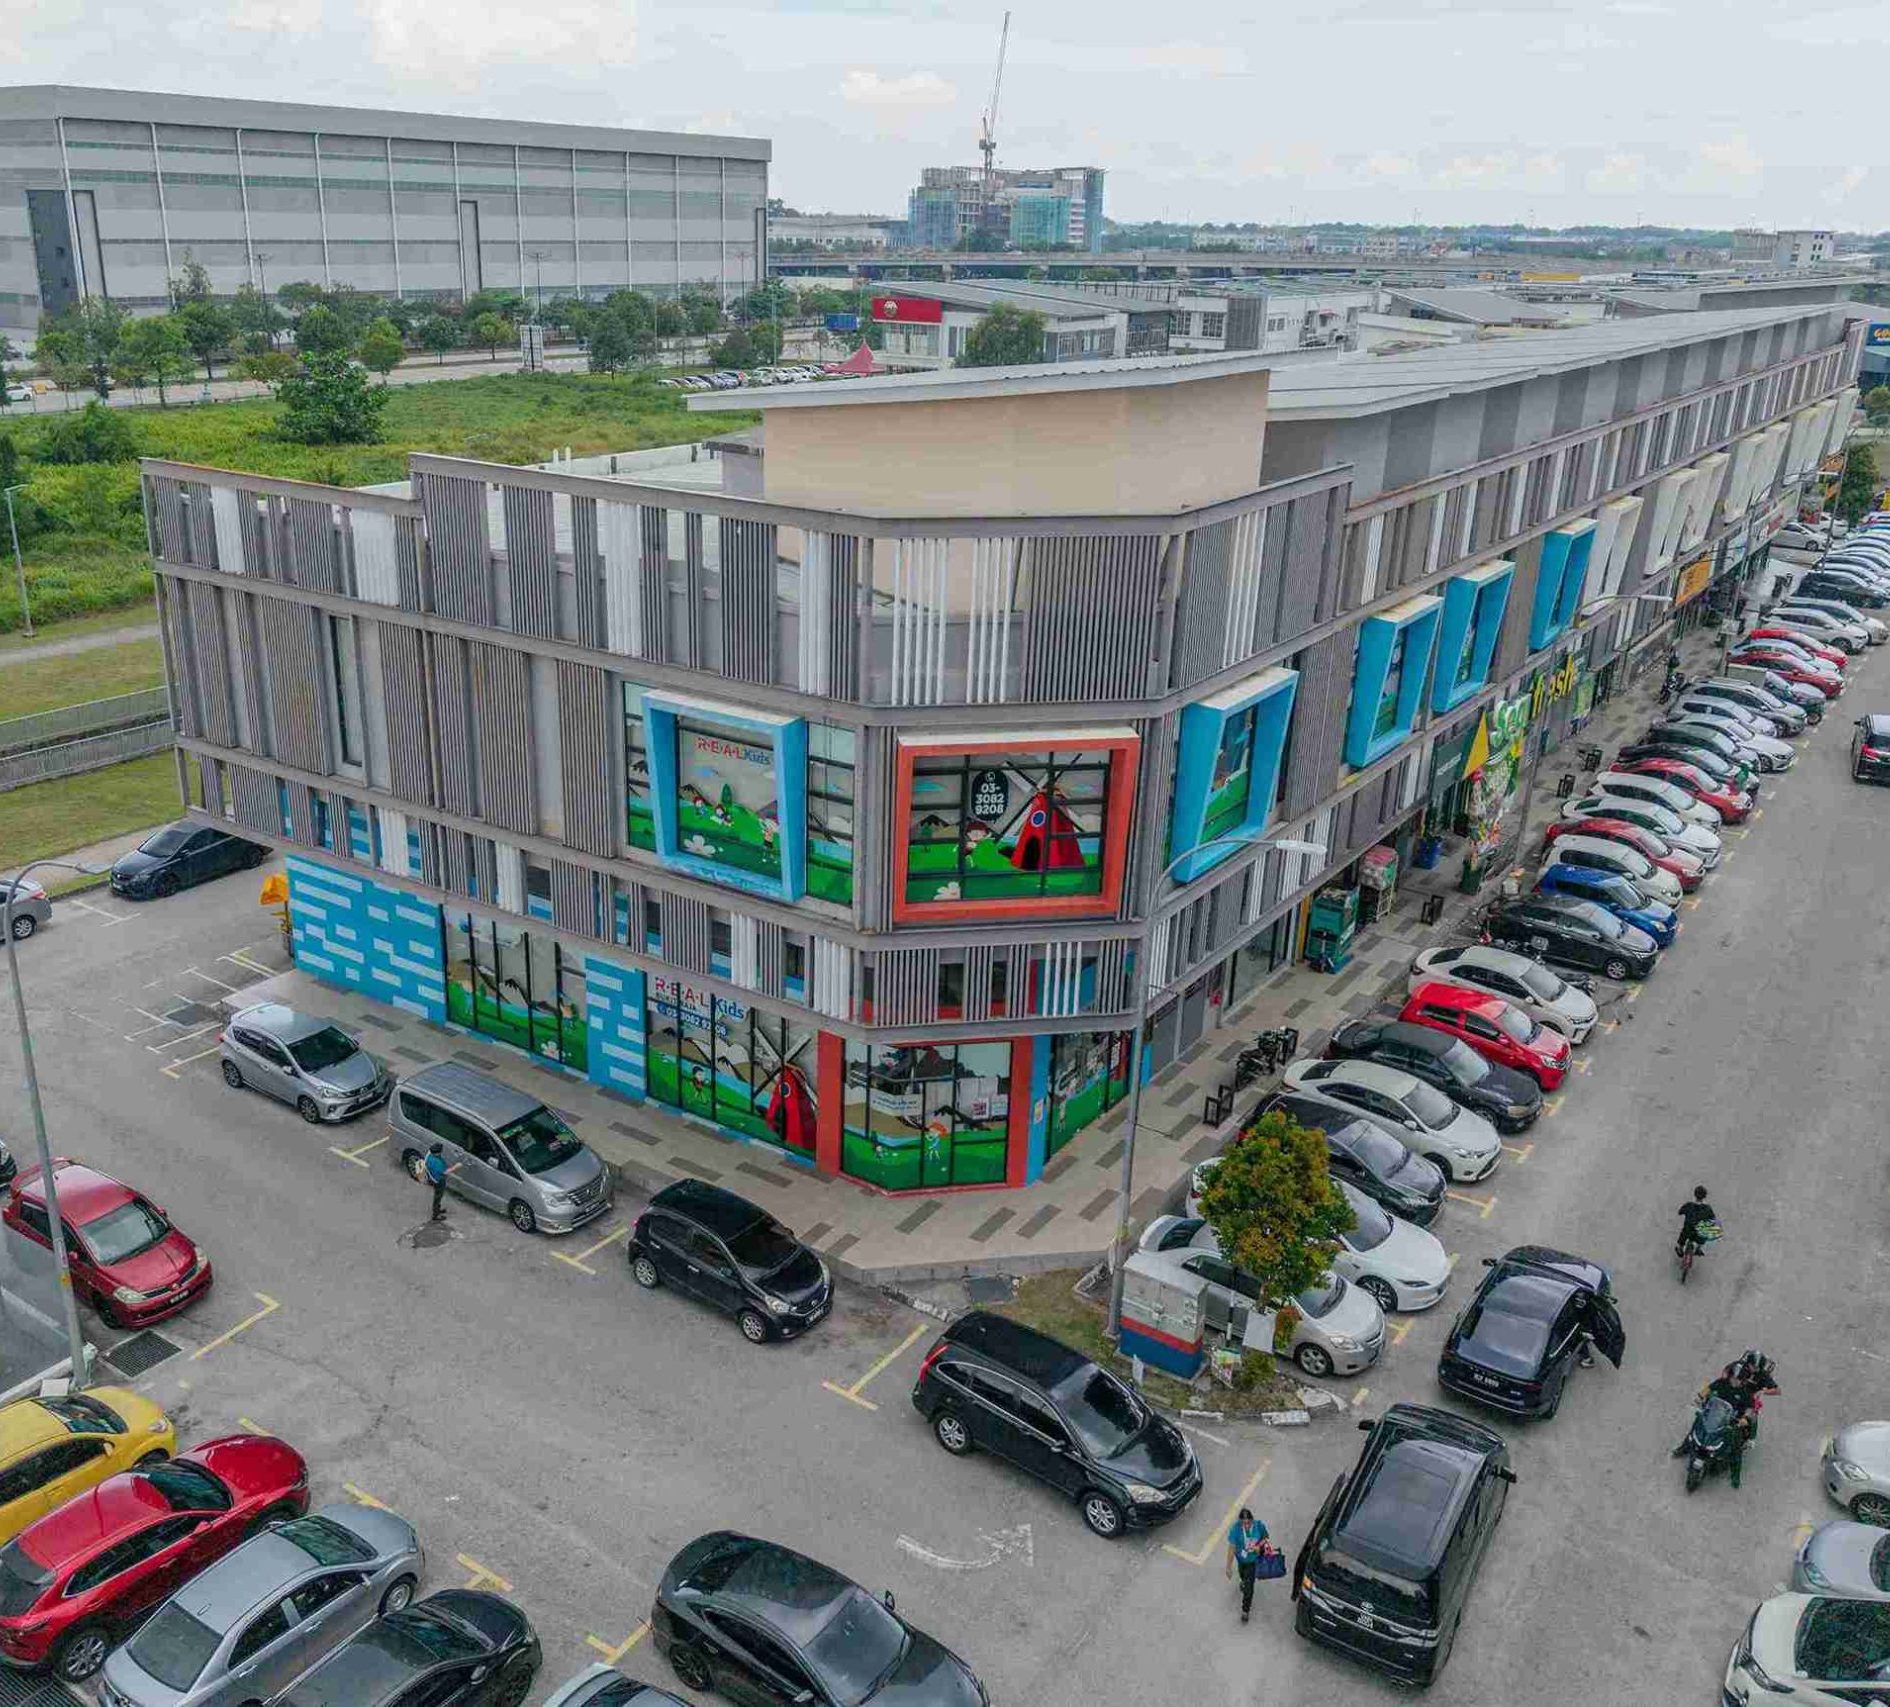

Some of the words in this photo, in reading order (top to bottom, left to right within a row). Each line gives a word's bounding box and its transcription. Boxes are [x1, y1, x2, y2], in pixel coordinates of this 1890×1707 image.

[981, 782, 1001, 793] 03-
[975, 793, 1004, 804] 3082
[975, 804, 1004, 815] 9208
[714, 998, 745, 1020] Kids
